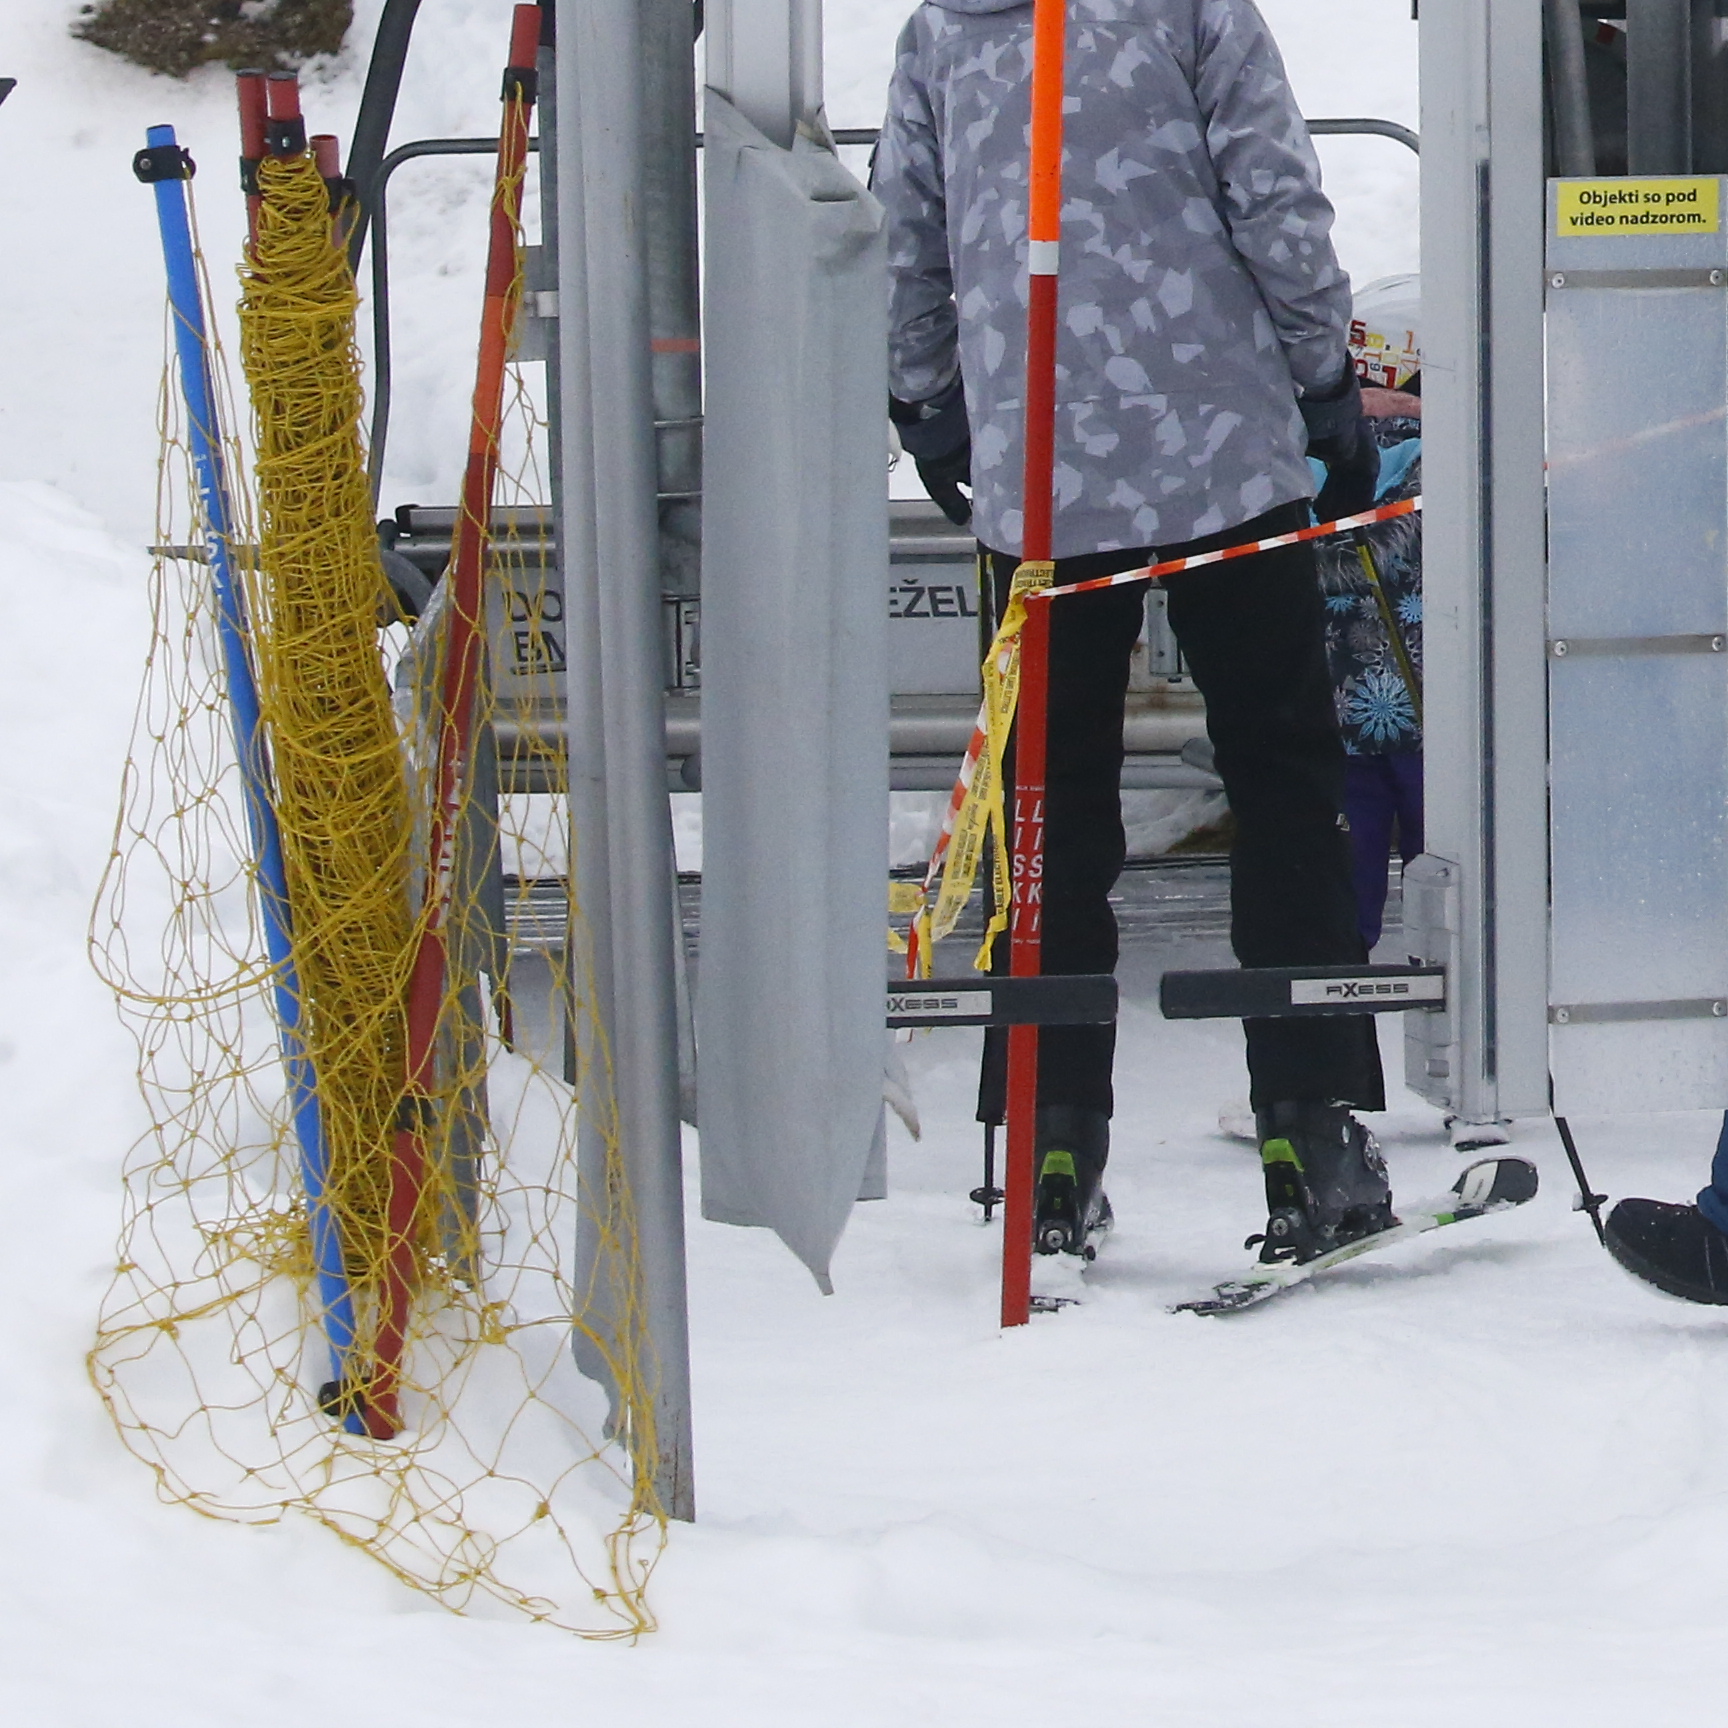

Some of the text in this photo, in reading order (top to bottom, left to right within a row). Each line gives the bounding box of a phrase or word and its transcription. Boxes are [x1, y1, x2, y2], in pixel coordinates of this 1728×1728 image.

[1580, 189, 1696, 207] Objekti so pod
[1570, 211, 1706, 225] video nadzorom.
[1327, 983, 1409, 998] AXESS
